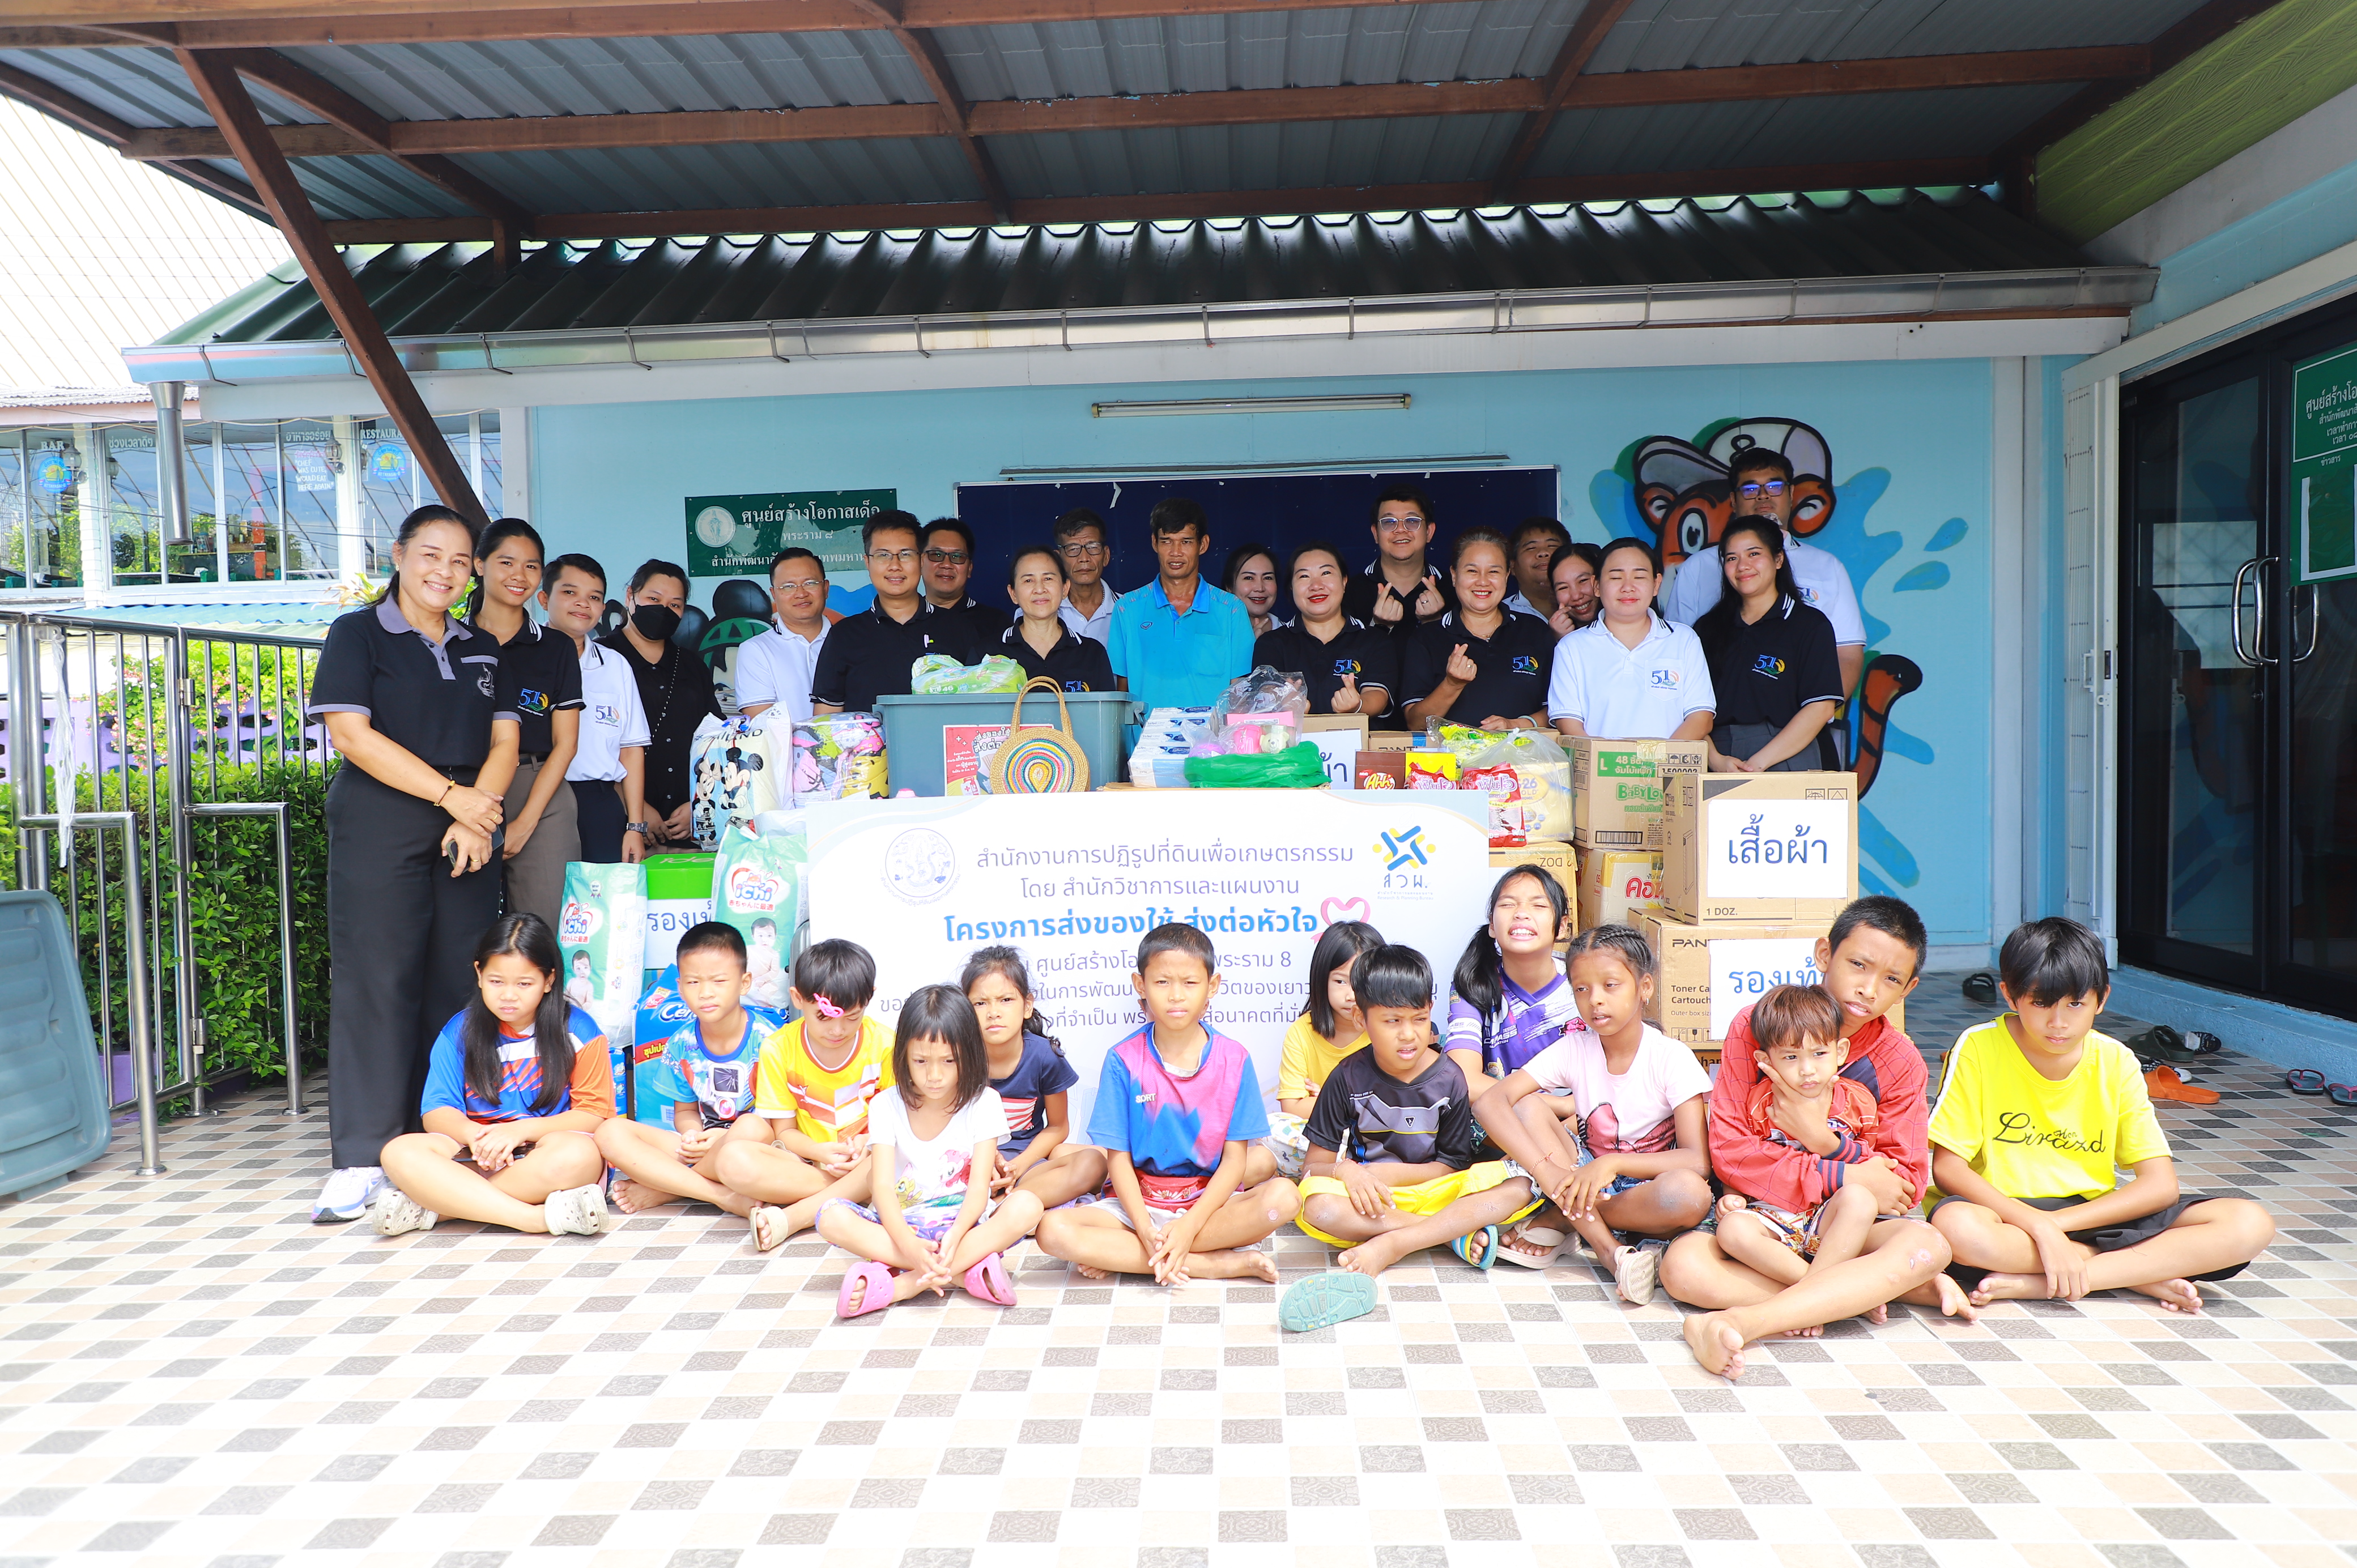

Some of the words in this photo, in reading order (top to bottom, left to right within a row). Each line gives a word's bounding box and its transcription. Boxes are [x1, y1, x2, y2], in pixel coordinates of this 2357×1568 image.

[360, 428, 403, 440] RESTAURA
[41, 441, 65, 450] BAR
[2321, 455, 2341, 466] ข่าวสาร
[782, 531, 822, 542] พระราม
[1333, 659, 1352, 674] 51
[1512, 655, 1530, 670] 51
[1755, 654, 1777, 669] 51
[1651, 669, 1670, 685] 51
[518, 688, 541, 706] 51
[595, 705, 613, 720] 51
[973, 738, 1003, 753] ส่งต่อ
[1600, 758, 1607, 770] L
[1615, 756, 1628, 764] 48
[1729, 813, 1828, 864] เสื้อผ้า
[977, 837, 1353, 868] สำนักงานการปฏิรูปที่ดินเพื่อเกษตรกรรม
[1020, 877, 1056, 898] โดย
[1063, 876, 1299, 897] สำนักวิชาการและแผนงาน
[729, 900, 774, 911] 赤ちゃんに最適
[1714, 907, 1738, 916] DOZ.
[1184, 906, 1318, 933] ส่งต่อหัวใจ
[1672, 938, 1709, 948] PAN
[1037, 949, 1138, 978] ศูนย์สร้างโอ
[1280, 952, 1292, 968] 8
[1729, 956, 1823, 994] รองเท้
[1671, 996, 1711, 1004] Cartouch
[661, 1003, 698, 1021] Cer
[1046, 1005, 1117, 1027] งที่จำเป็น
